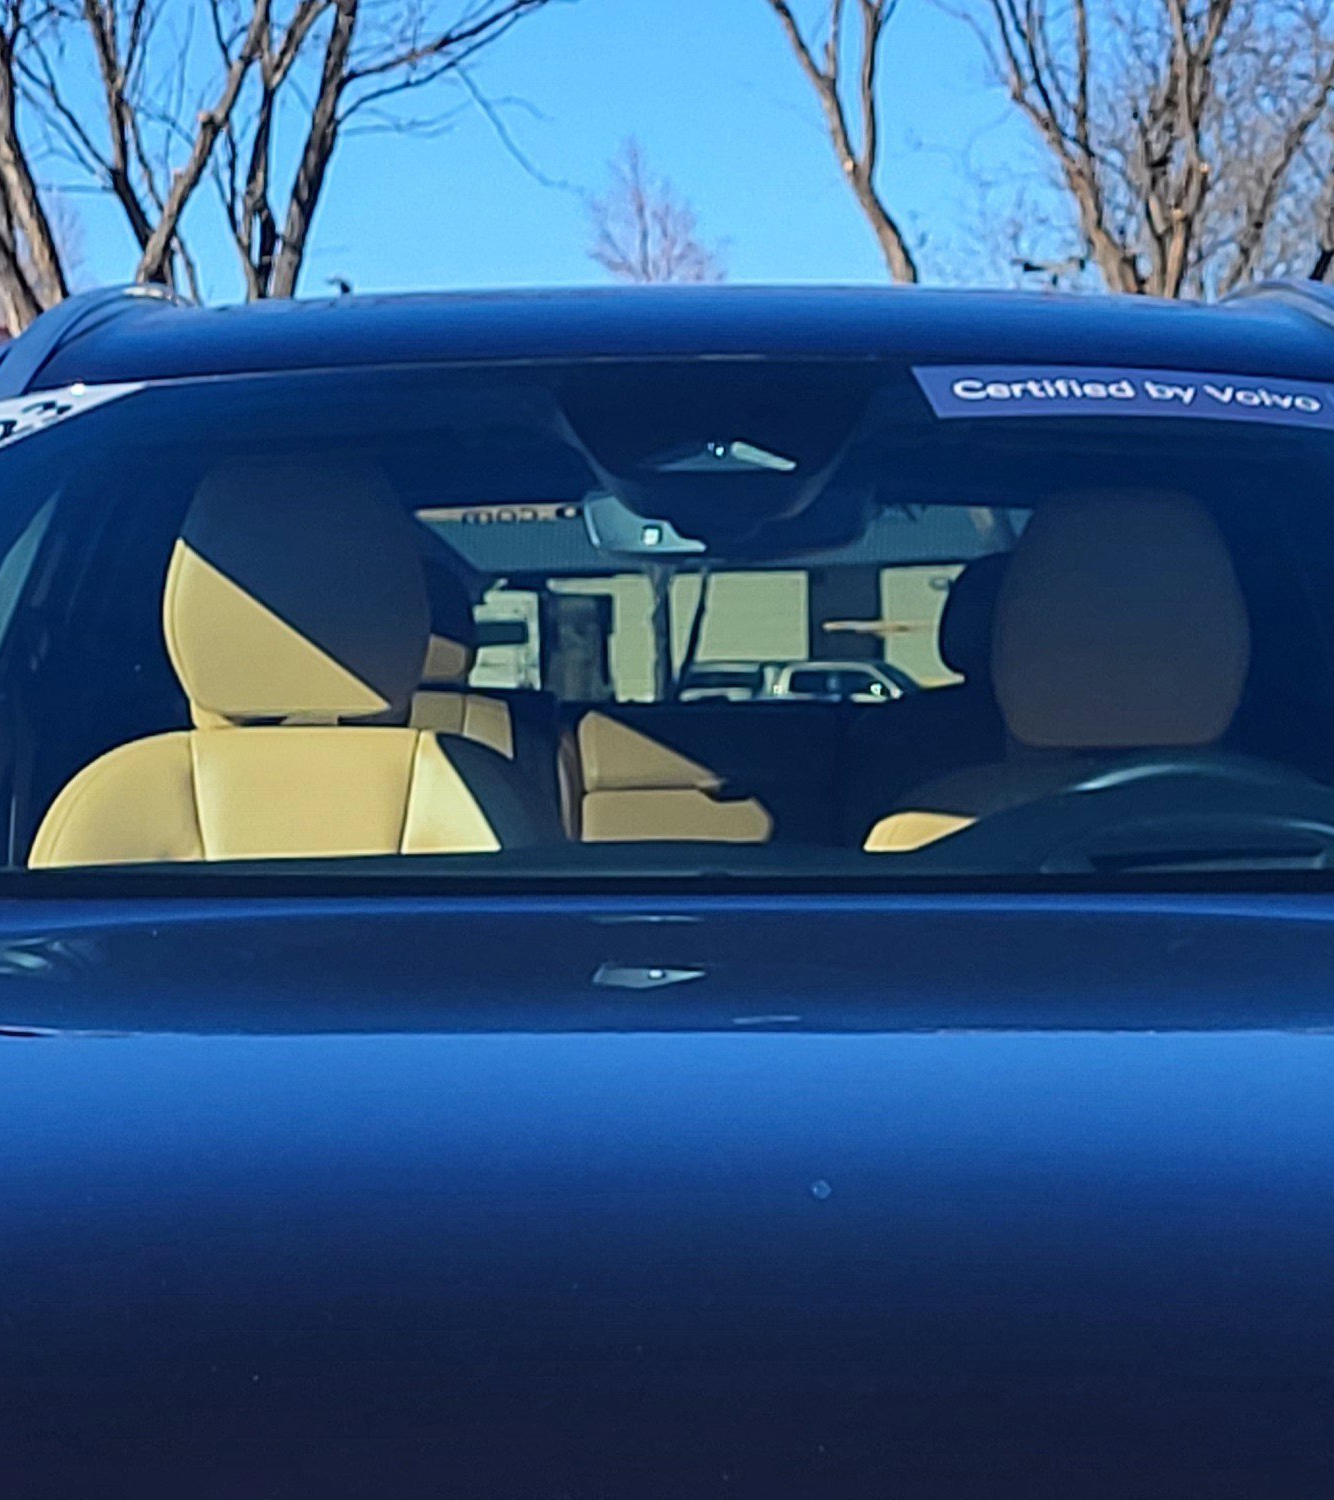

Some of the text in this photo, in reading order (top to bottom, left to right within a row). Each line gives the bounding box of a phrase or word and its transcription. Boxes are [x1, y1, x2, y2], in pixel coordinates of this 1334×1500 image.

[953, 378, 1321, 412] Certified by Volvo
